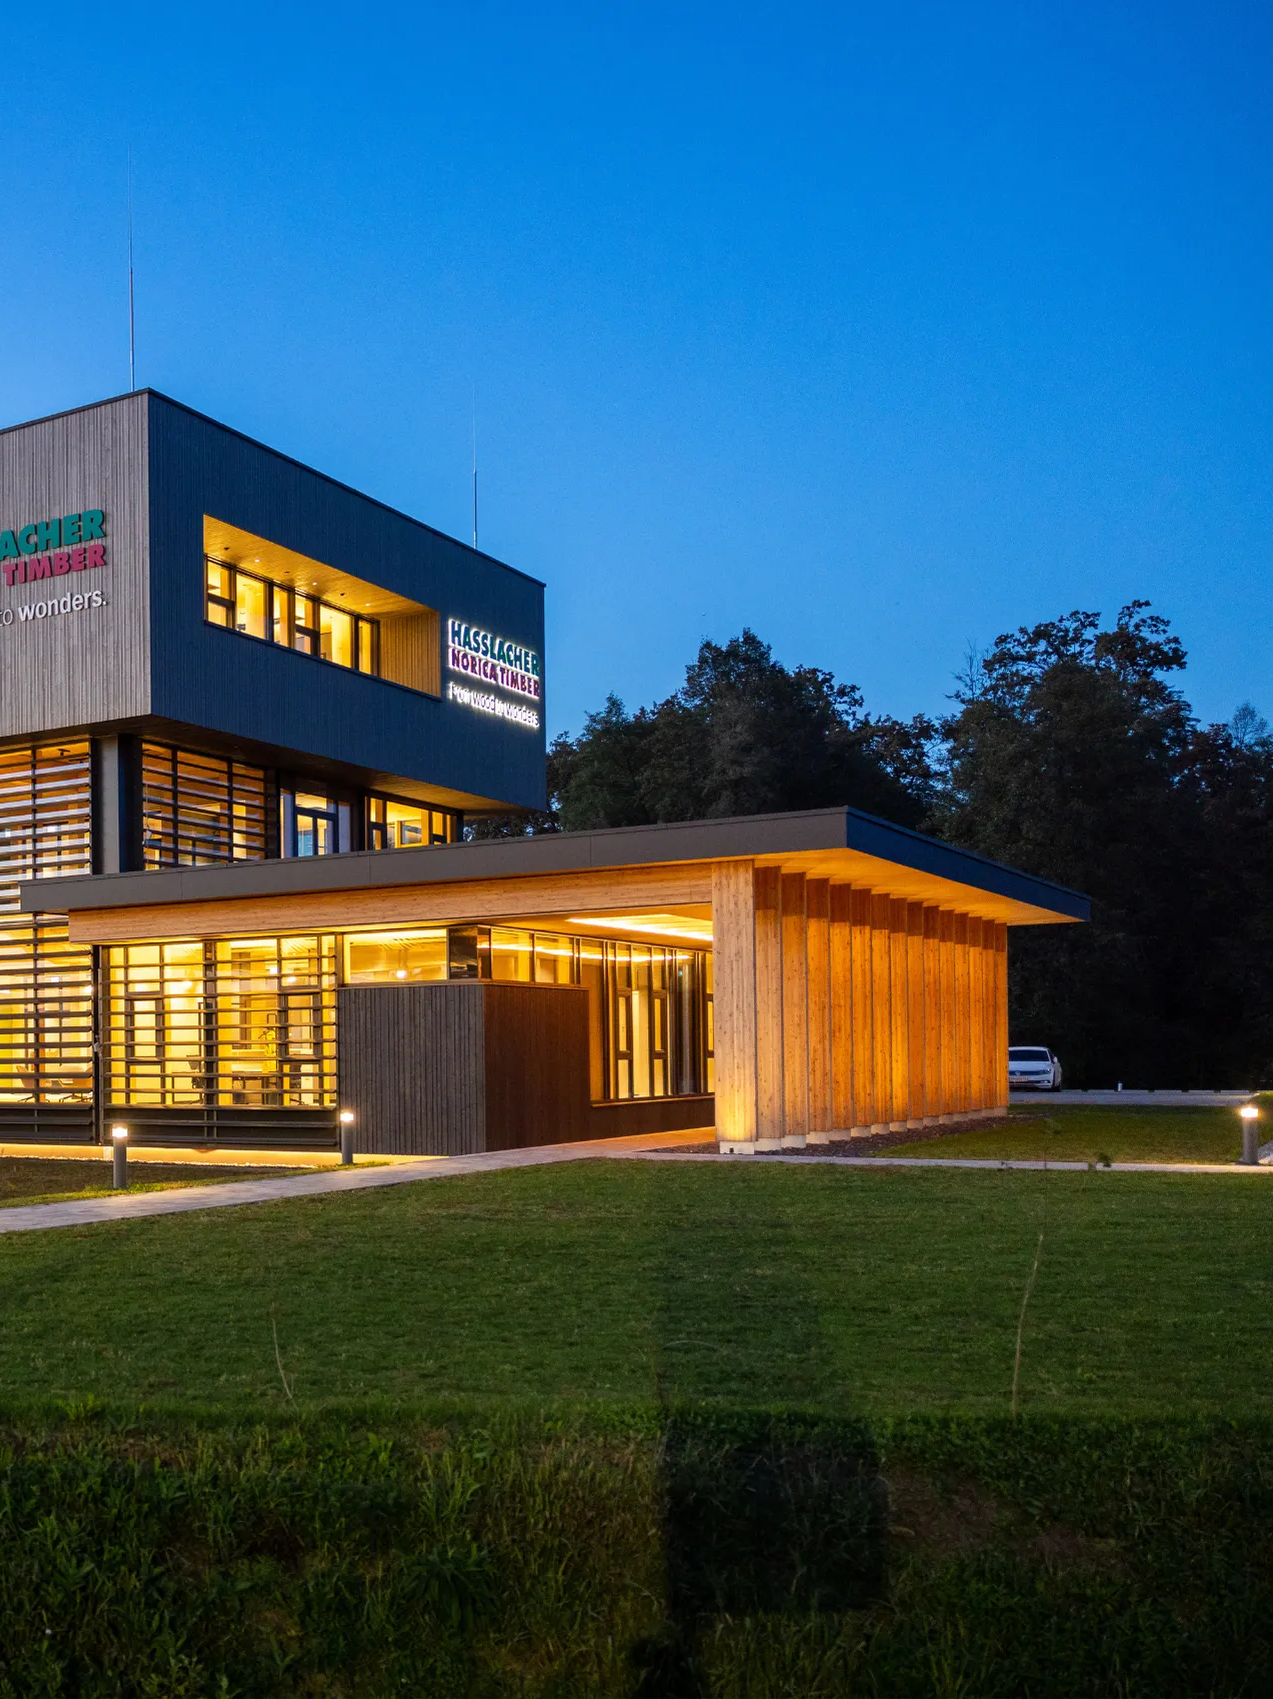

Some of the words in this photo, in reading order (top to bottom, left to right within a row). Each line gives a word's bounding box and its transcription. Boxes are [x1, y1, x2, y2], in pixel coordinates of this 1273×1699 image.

[3, 544, 106, 586] TIMBER
[18, 589, 108, 622] wonders.
[449, 619, 540, 678] HASSLACHER
[449, 648, 496, 684] NORICA
[498, 666, 540, 699] TIMBER
